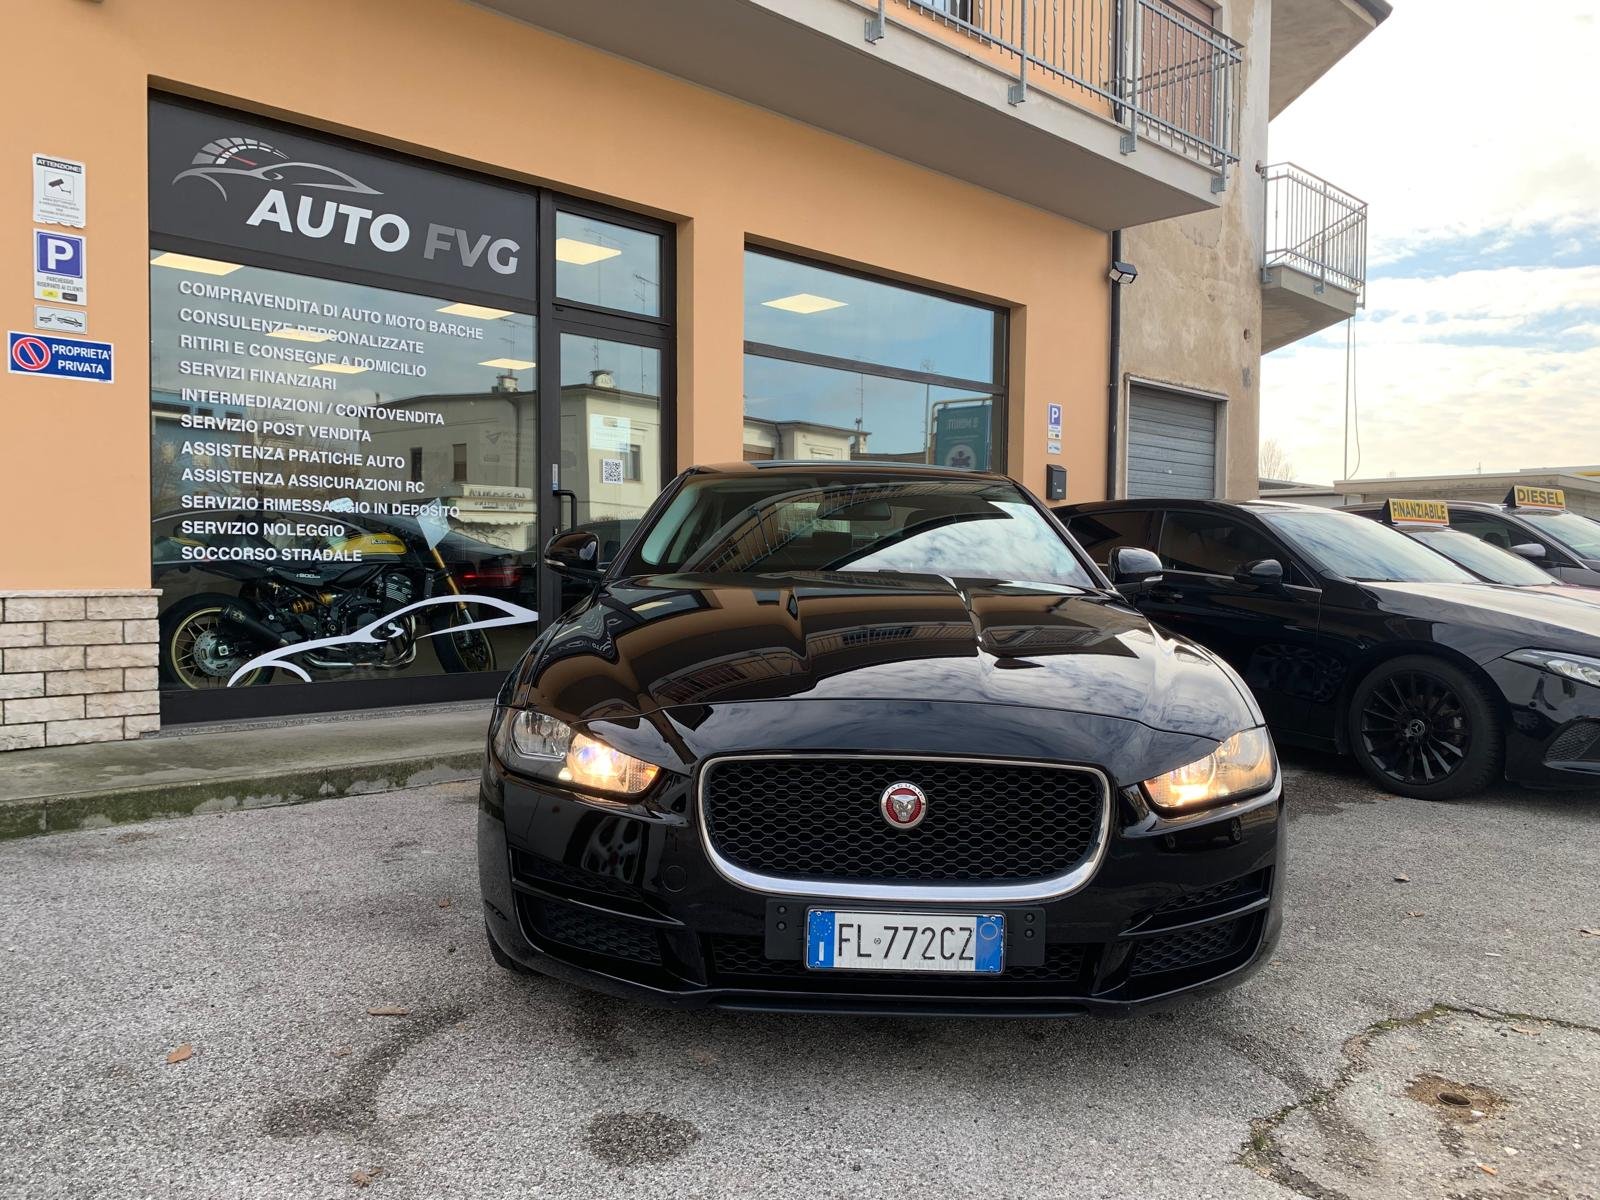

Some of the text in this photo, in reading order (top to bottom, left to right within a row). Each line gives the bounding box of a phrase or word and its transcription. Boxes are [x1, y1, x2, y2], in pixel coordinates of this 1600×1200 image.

[245, 188, 521, 275] AUTO FVG
[47, 238, 74, 270] P
[180, 280, 484, 340] COMPRAVENDITA DI AUTO MOTO BARCHE
[180, 308, 425, 354] CONSULENZE PERSONALIZZATE
[57, 360, 105, 374] PRIVATA
[180, 334, 427, 377] RITIRI E CONSEGNE A DOMICILIO
[180, 360, 337, 390] SERVIZI FINANZIARI
[181, 388, 445, 425] INTERMEDIAZIONI / CONTOVENDITA
[1051, 407, 1059, 423] P
[181, 414, 372, 442] SERVIZIO POST VENDITA
[181, 441, 406, 469] ASSISTENZA PRATICHE AUTO
[181, 468, 425, 494] ASSISTENZA ASSICURAZIONI RC
[181, 495, 259, 510] SERVIZIO
[263, 498, 370, 514] RIMESSAGIO
[374, 503, 388, 515] IN
[392, 504, 460, 518] DEPOSITO
[1391, 501, 1447, 520] FINANZIABILE
[1516, 488, 1564, 506] DIESEL
[181, 520, 345, 538] SERVIZIO NOLEGGIO
[181, 546, 363, 562] SOCCORSO STRADALE
[837, 923, 974, 961] FL 772CZ
